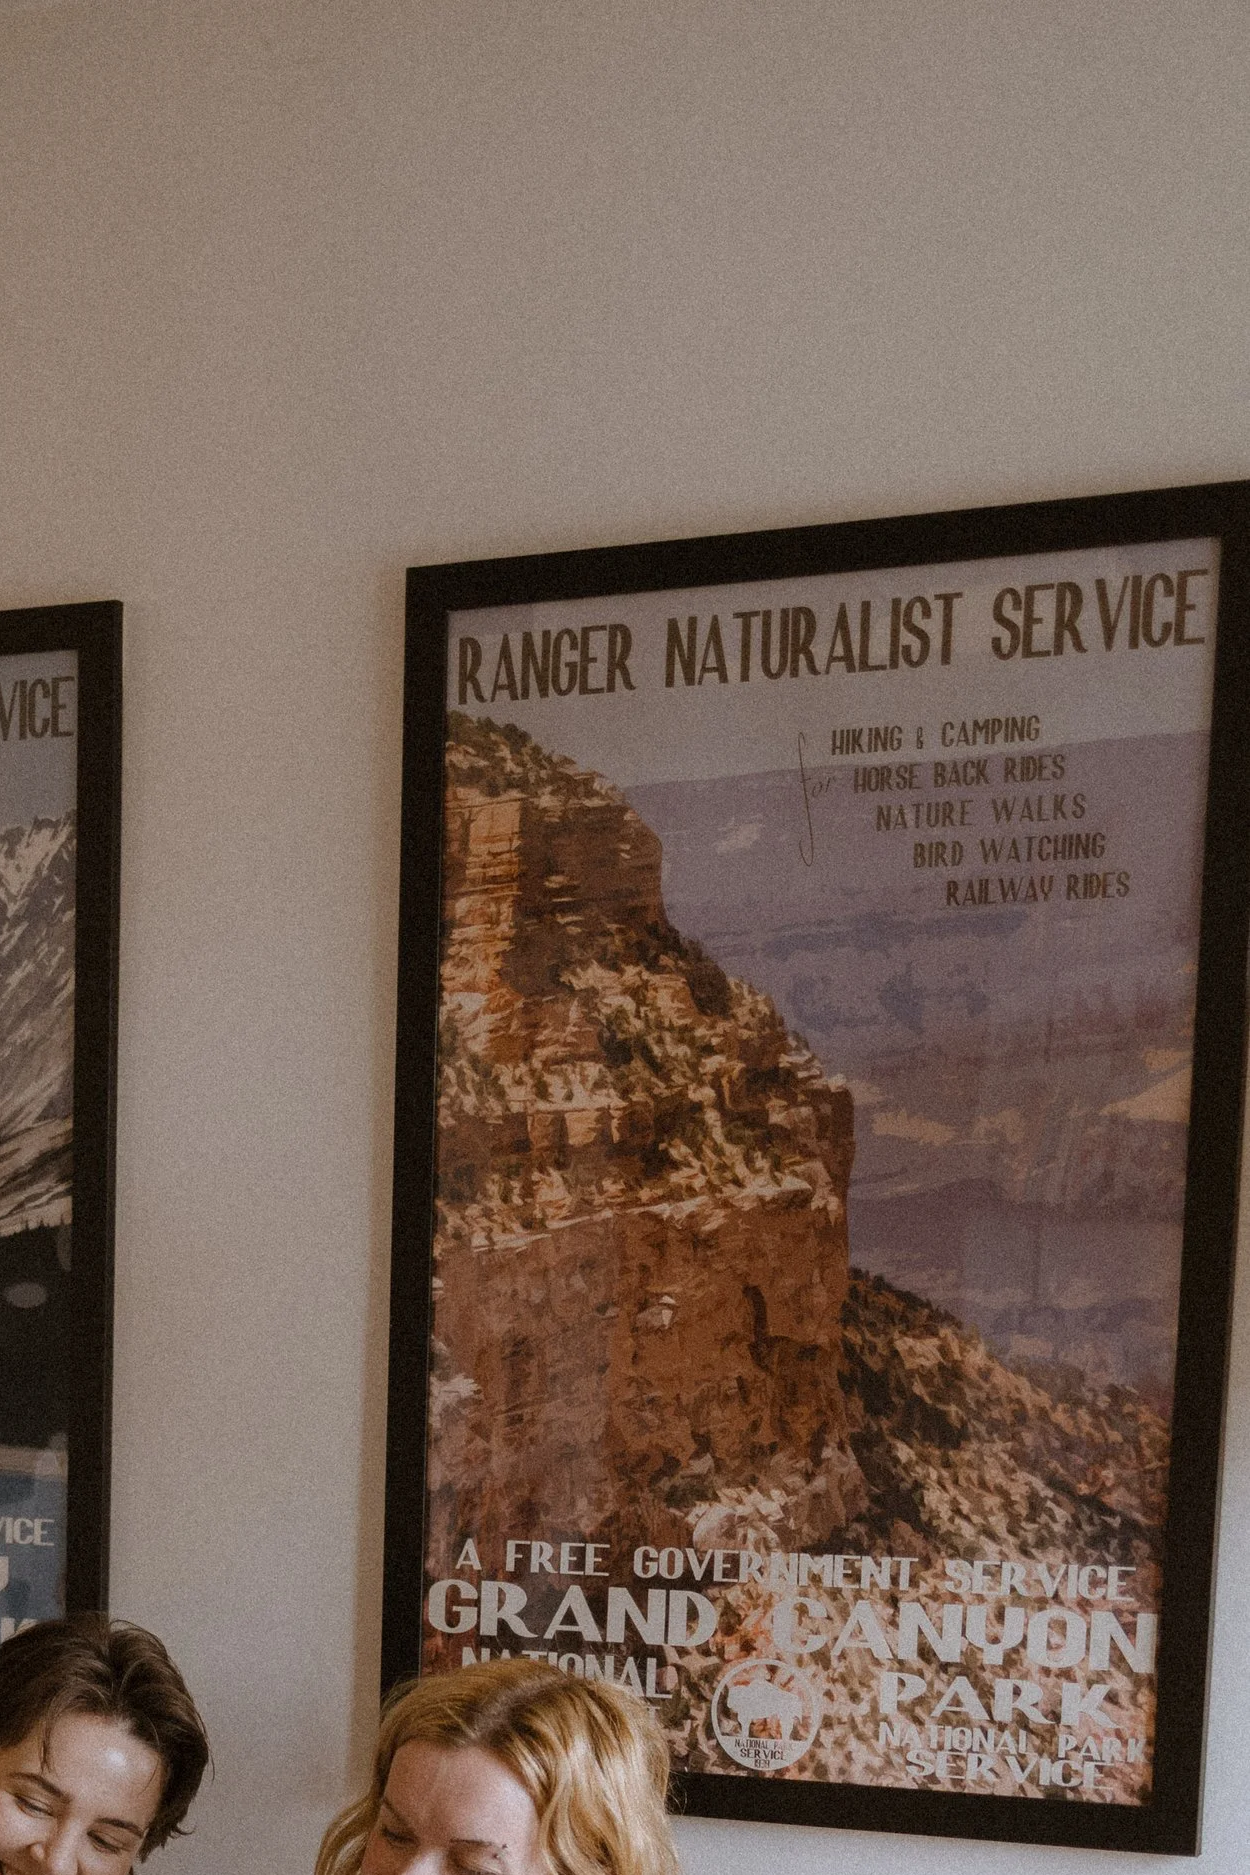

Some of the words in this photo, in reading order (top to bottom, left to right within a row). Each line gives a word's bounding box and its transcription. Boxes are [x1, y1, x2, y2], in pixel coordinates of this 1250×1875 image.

[457, 623, 634, 704] RANGER
[665, 592, 963, 687] NATURALIST
[990, 569, 1209, 662] SERVICE
[831, 726, 903, 755] HIKING
[941, 714, 1041, 747] CAMPING
[853, 762, 920, 794] HORSE
[933, 758, 990, 788] BACK
[1004, 753, 1066, 784] RIDES
[876, 799, 974, 831] NATURE
[992, 793, 1087, 822] WALKS
[913, 840, 965, 869] BIRD
[979, 832, 1107, 865] WATCHING
[946, 875, 1054, 906] RAILWAY
[1065, 872, 1131, 902] RIDES
[455, 1539, 482, 1571] A
[505, 1540, 611, 1577] FREE
[633, 1545, 921, 1593] GOVERNMENT
[943, 1559, 1138, 1602] SERVICE
[427, 1579, 718, 1649] GRAND
[771, 1597, 1159, 1675] CANYON
[461, 1647, 674, 1699] NIONAL
[878, 1671, 1124, 1729] PARK
[735, 1738, 769, 1750] NATIONAL
[740, 1748, 786, 1761] SERVICE
[878, 1722, 1037, 1754] NATIONAL
[1057, 1733, 1146, 1763] PARK
[905, 1749, 1117, 1790] SERVICE
